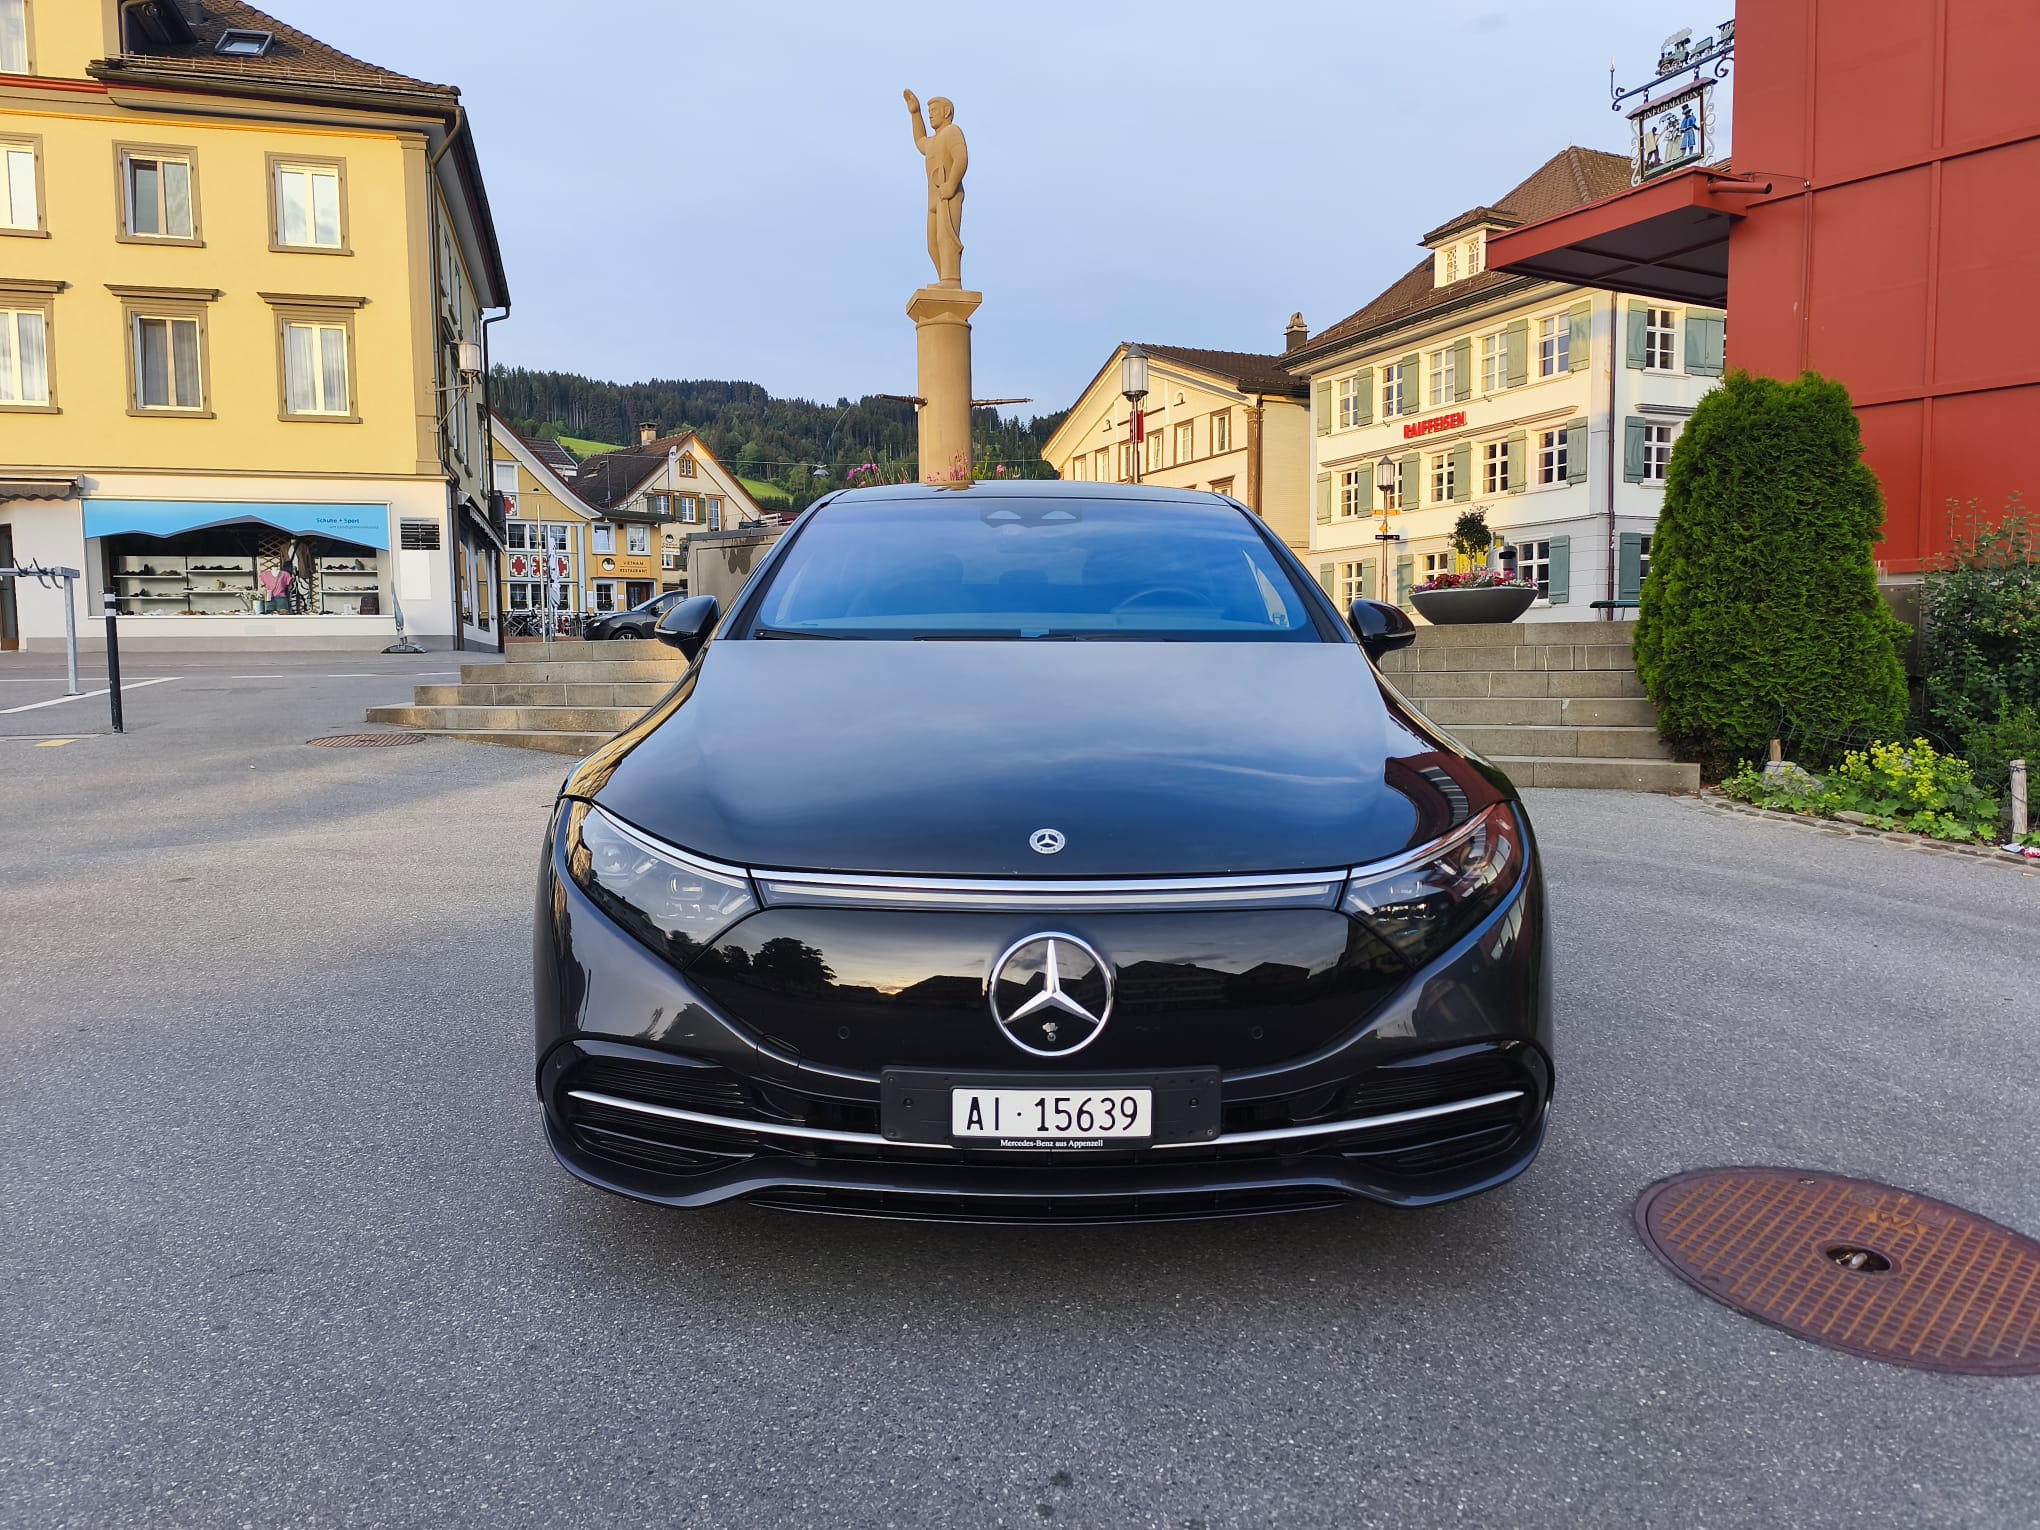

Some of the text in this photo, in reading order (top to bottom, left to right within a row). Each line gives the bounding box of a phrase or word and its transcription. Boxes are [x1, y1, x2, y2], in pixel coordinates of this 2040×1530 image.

[1644, 90, 1699, 119] INFORMATION
[1404, 411, 1465, 439] RAIFFEISEN
[344, 517, 360, 525] Sport
[1034, 1096, 1138, 1132] 15639
[1000, 1139, 1054, 1147] Mercedes-Benz
[1068, 1139, 1104, 1149] Appenzell
